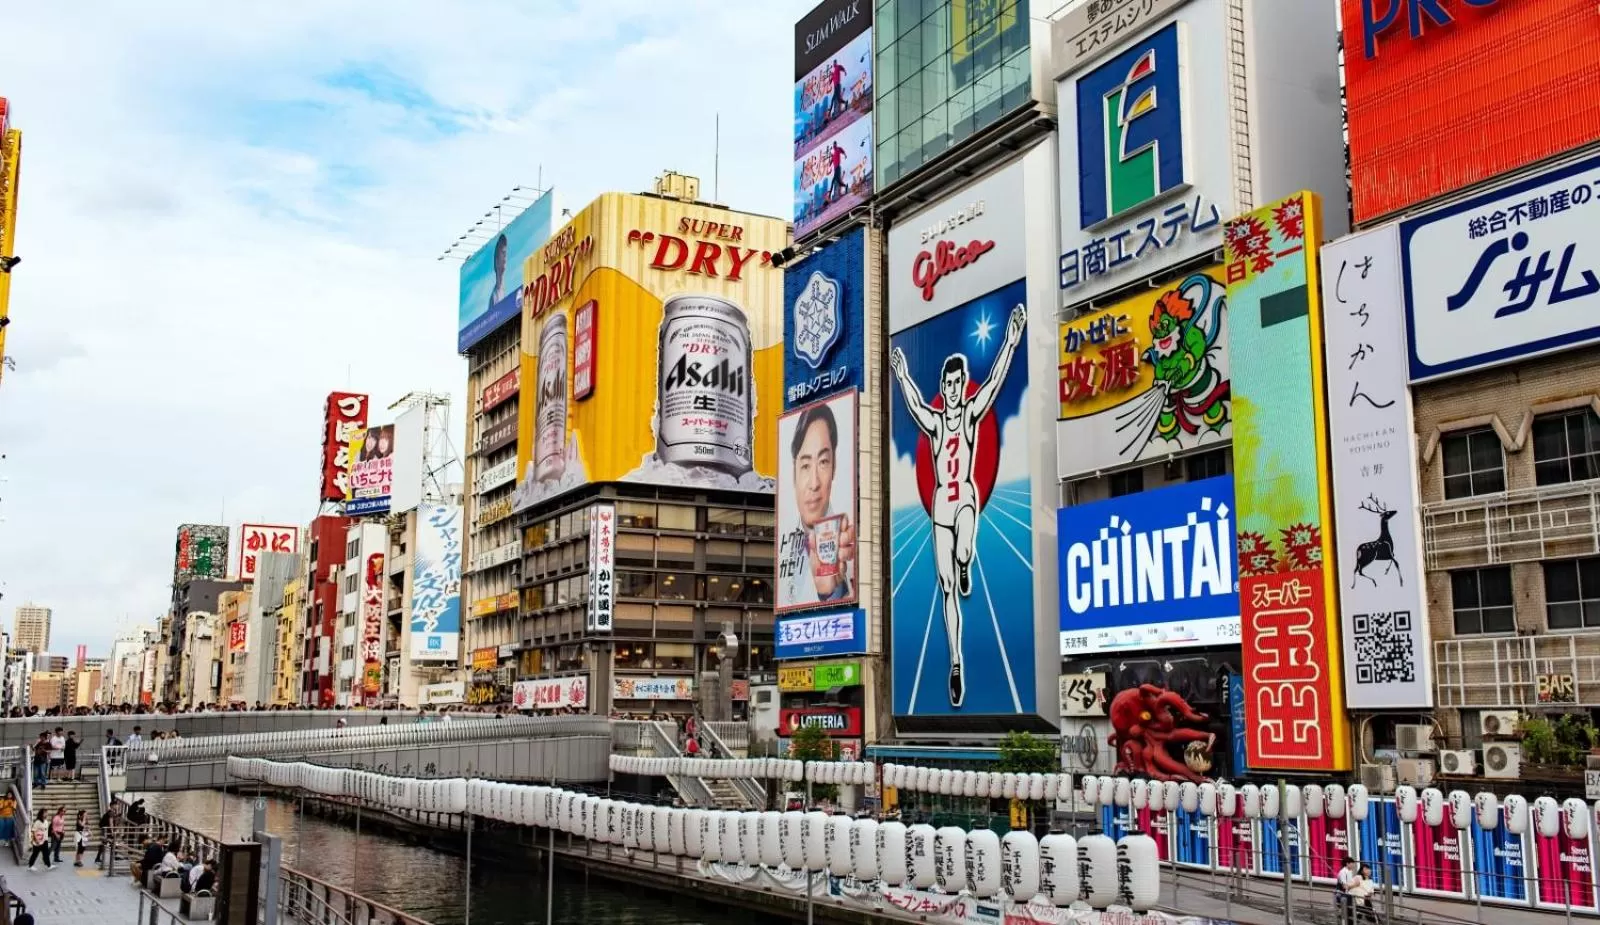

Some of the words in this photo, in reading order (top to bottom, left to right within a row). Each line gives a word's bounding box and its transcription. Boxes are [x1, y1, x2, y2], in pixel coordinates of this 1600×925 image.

[805, 28, 829, 54] SLIM
[829, 1, 860, 37] WALK
[678, 216, 744, 241] SUPER
[1059, 194, 1221, 290] 日商エステム
[912, 239, 995, 301] Glico
[1227, 245, 1303, 285] 日本一
[1064, 313, 1132, 354] かぜに
[665, 353, 744, 397] Asahi
[788, 366, 846, 402] 雪印メグミルク
[1057, 337, 1141, 404] 改源
[694, 395, 716, 412] 生
[682, 417, 729, 431] スーパードライ
[693, 445, 715, 456] 350ml
[945, 432, 960, 502] グリコ
[246, 530, 291, 552] かに
[1067, 497, 1232, 614] CHINTAI
[1252, 579, 1312, 608] スーパー
[1064, 637, 1088, 650] 天気予報
[1537, 674, 1573, 694] BAR
[801, 715, 844, 728] LOTTERIA
